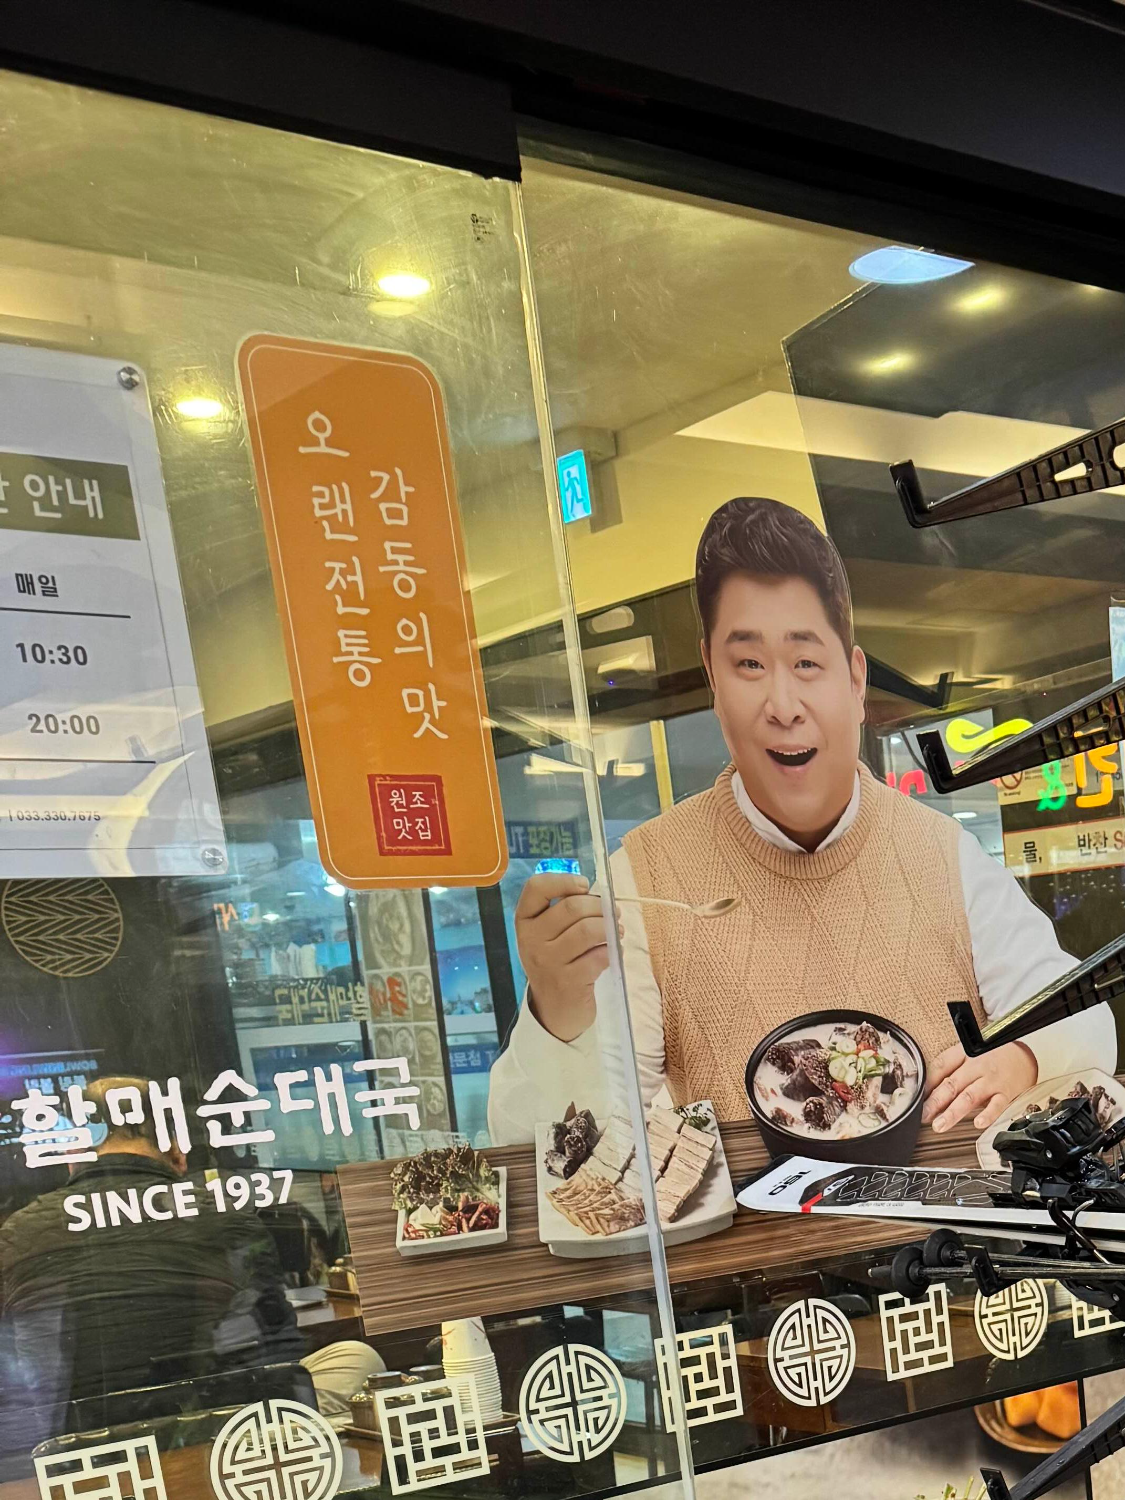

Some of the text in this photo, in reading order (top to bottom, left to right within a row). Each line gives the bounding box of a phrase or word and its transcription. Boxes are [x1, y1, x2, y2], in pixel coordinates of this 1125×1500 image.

[23, 473, 104, 520] 안내
[15, 572, 59, 598] 매일
[15, 642, 88, 666] 10:30
[27, 713, 100, 736] 20:00
[388, 788, 430, 813] 원조
[392, 815, 432, 841] 맛집
[10, 1056, 422, 1169] 할매순대국
[62, 1169, 294, 1232] SINCE 1937
